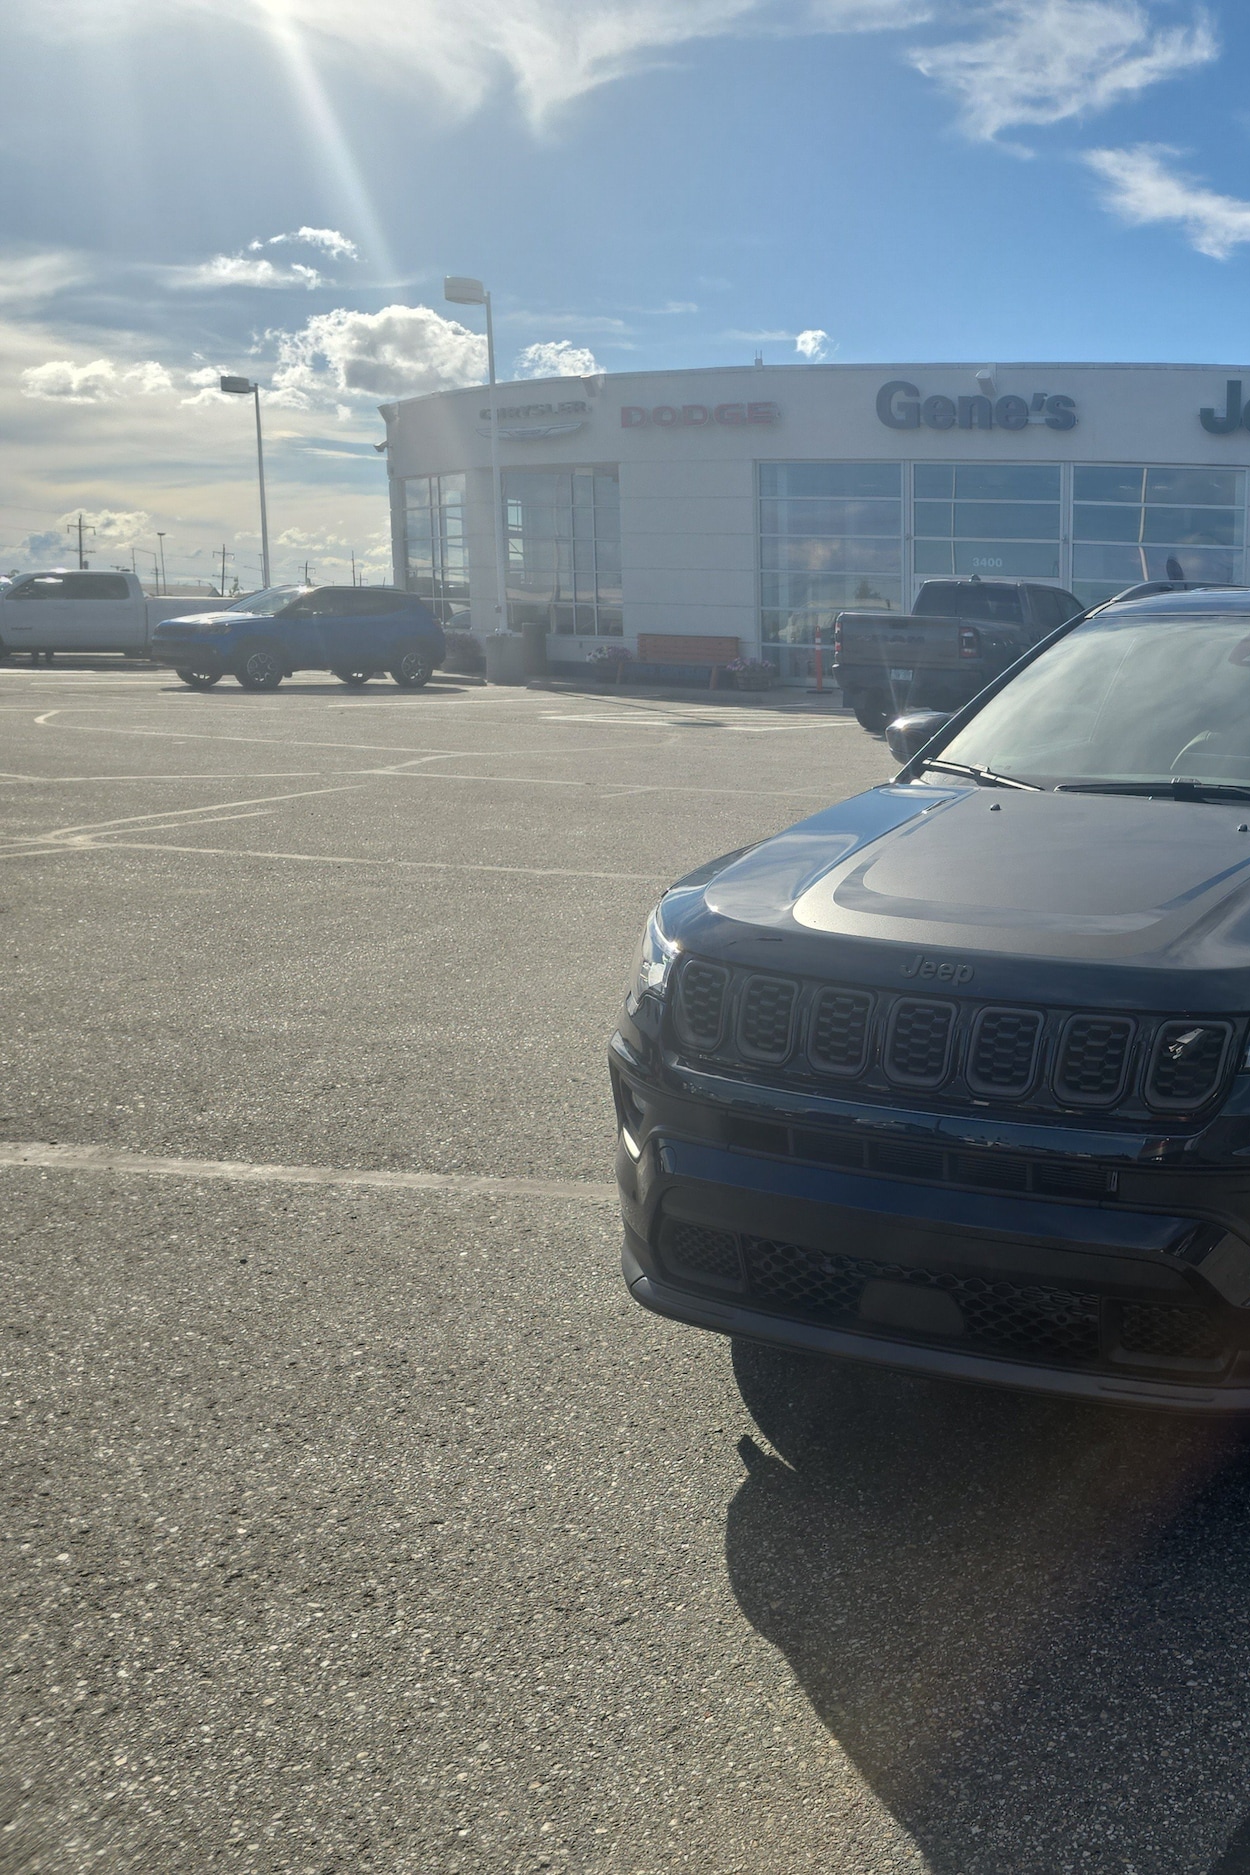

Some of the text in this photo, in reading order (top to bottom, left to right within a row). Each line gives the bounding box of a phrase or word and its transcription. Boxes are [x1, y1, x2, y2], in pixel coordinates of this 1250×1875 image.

[621, 402, 778, 429] DODGE
[876, 381, 1077, 431] Gene's
[972, 557, 1003, 567] 3400
[900, 955, 975, 986] Jeep
